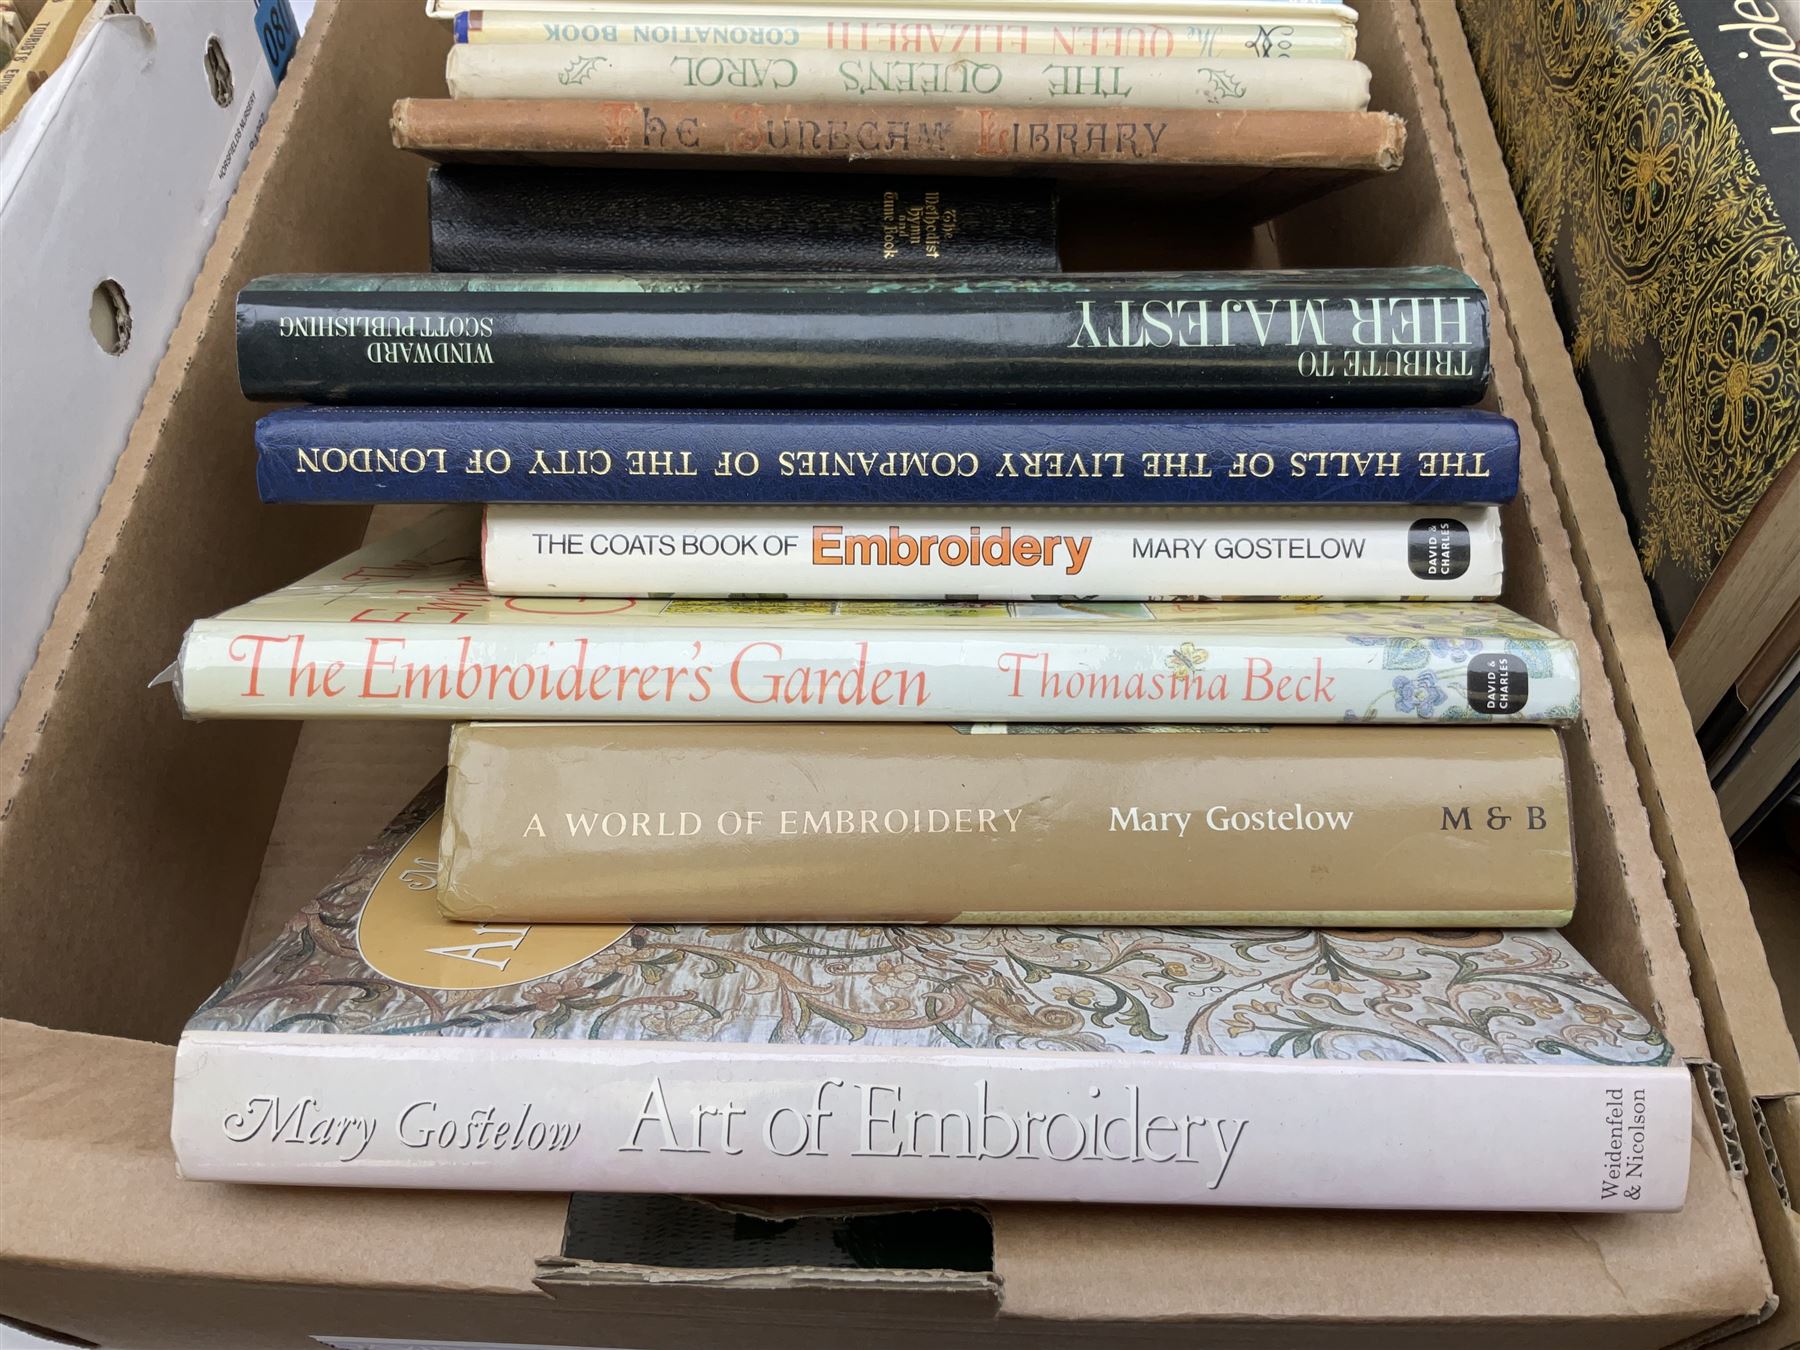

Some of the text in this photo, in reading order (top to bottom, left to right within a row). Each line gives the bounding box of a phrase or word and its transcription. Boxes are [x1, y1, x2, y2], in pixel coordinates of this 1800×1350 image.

[545, 23, 618, 43] BOOK
[633, 24, 800, 45] CORONATION
[826, 22, 1028, 54] ELIZABETH
[1053, 24, 1174, 58] QUEEN
[670, 56, 1132, 98] THE QUEEN'S CAROL
[975, 110, 1168, 157] LIBRARY
[883, 192, 899, 259] Tune Book
[899, 215, 909, 237] and
[907, 207, 924, 244] Hymn
[923, 192, 940, 259] Methodist
[943, 209, 957, 240] The
[280, 316, 494, 338] SCOTT PUBLISHING
[1067, 296, 1473, 348] HER MAJESTY
[367, 342, 495, 364] WINDWARD
[1298, 350, 1473, 377] TRIBUTE TO
[296, 447, 1490, 478] THE HALLS OF THE LIVERY COMPANIES OF THE CITY OF LONDON
[532, 525, 1366, 575] THE COATS BOOK OF Embroidery MARY GOSTELOW
[1428, 537, 1437, 574] DAVID
[1441, 523, 1450, 574] CHARLES
[228, 634, 1337, 706] The Embroiderer's Garden Thomasina Beck
[1499, 658, 1508, 709] CHARLES
[1487, 672, 1496, 708] DAVID
[522, 803, 1547, 838] A WORLD OF EMBROIDERY Mary Gostelow M & B
[223, 1076, 1250, 1190] Mary Gostelow Art of Embroidery
[1601, 1088, 1623, 1200] Weidenfeld
[1623, 1088, 1646, 1200] & Nicolson
